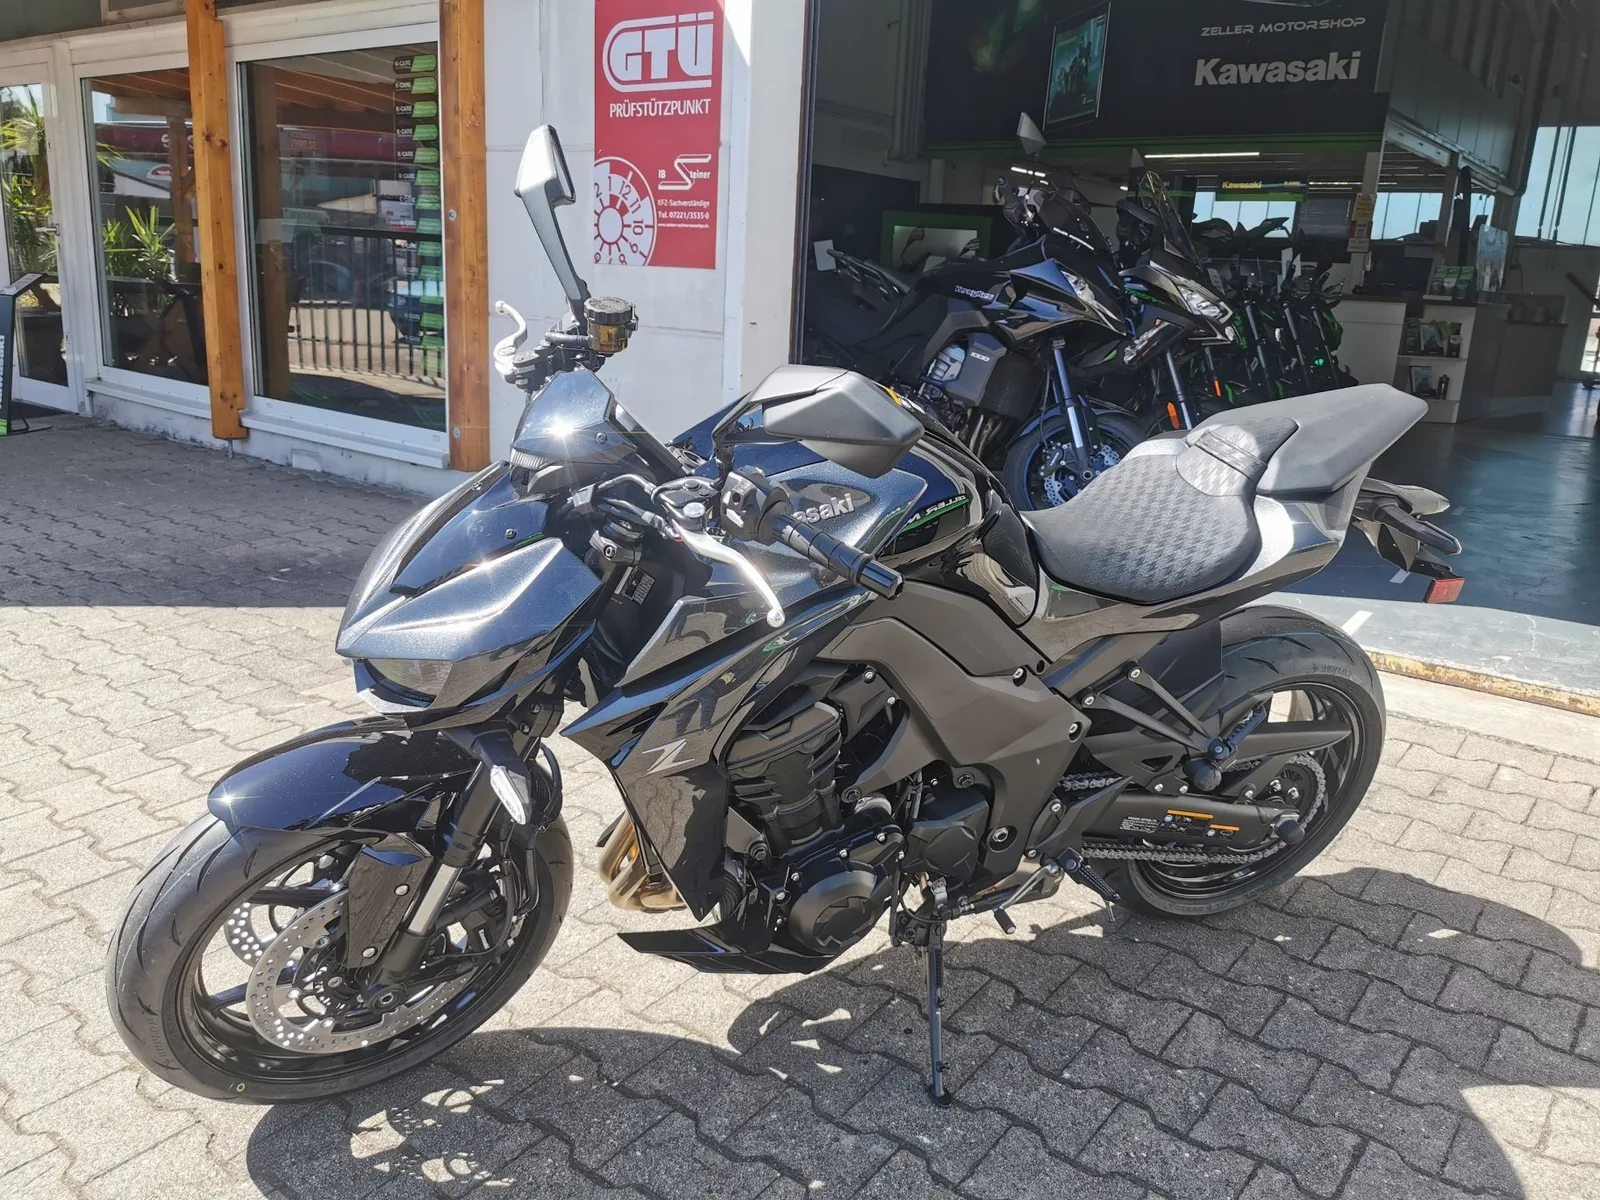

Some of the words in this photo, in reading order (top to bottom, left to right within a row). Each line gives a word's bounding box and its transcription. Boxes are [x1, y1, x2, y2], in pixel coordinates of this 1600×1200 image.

[1201, 25, 1255, 37] ZELLER
[1259, 17, 1366, 33] MOTORSHOP
[608, 11, 714, 82] GTÜ
[1194, 51, 1362, 86] Kawasaki
[609, 98, 712, 118] PRÜFSTÜTZPUNKT
[658, 169, 667, 179] IB
[791, 493, 855, 524] asaki
